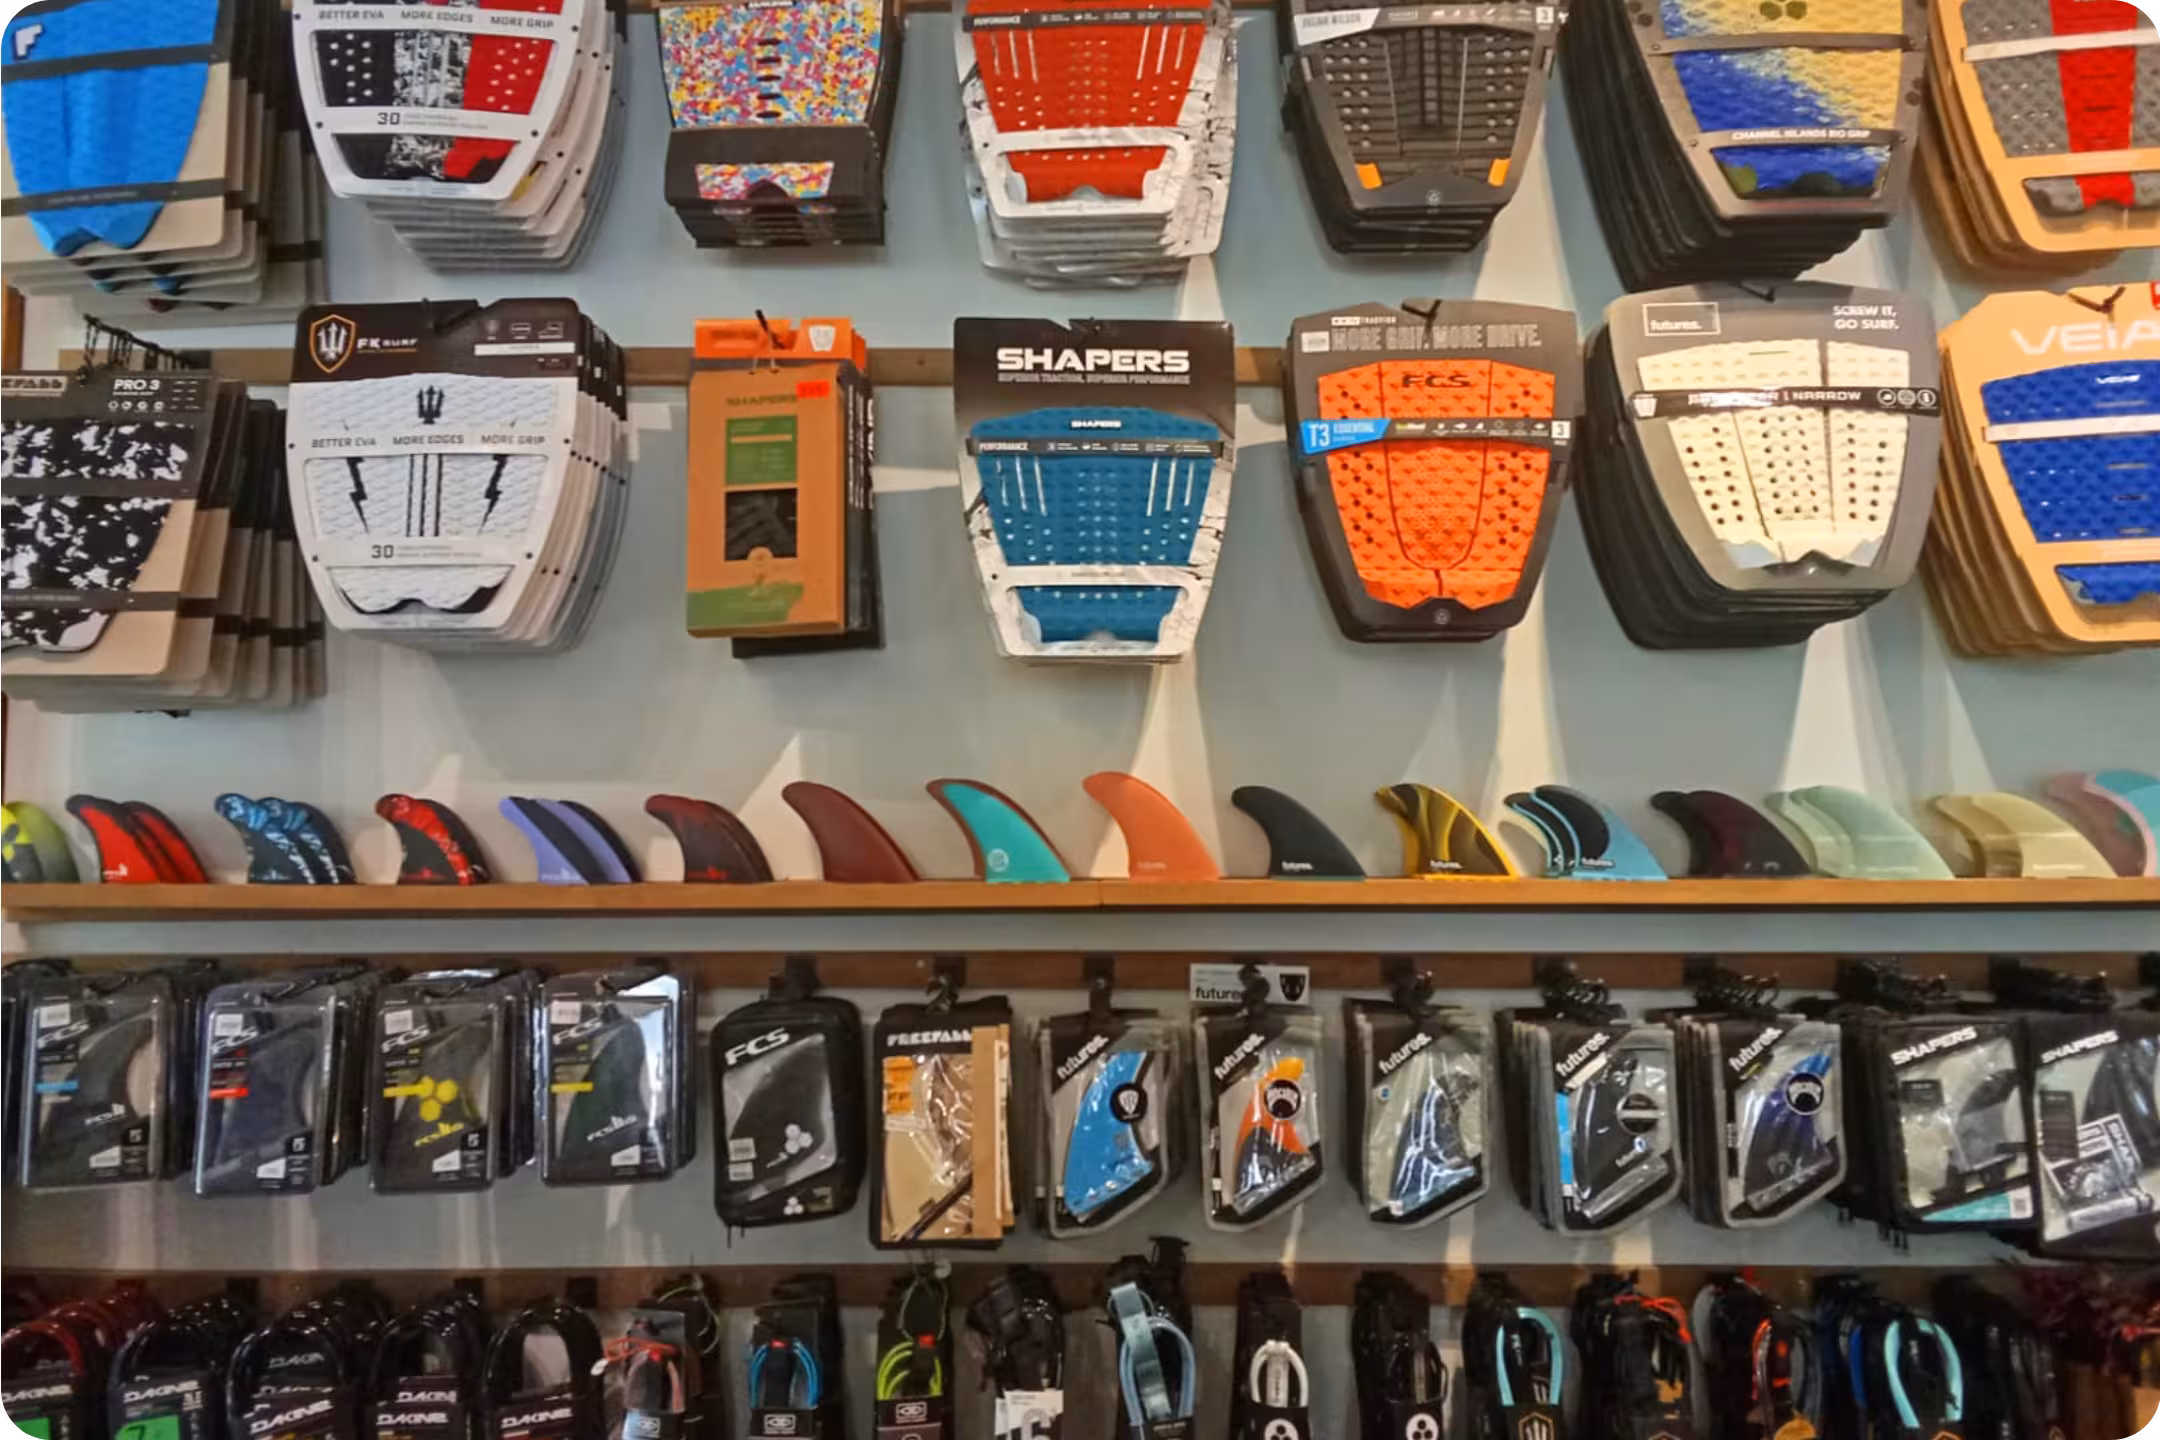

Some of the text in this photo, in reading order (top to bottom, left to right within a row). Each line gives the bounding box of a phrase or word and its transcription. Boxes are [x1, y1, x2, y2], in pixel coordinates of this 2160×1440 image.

[319, 10, 554, 28] BETTER EVA MORE EDGES MORE GRIP
[378, 113, 400, 125] 30
[1732, 130, 1782, 140] CHANNEL
[1783, 129, 1827, 139] ISLANDS
[1833, 305, 1878, 317] SCREW
[1834, 318, 1858, 330] GO
[997, 348, 1190, 372] SHAPERS
[113, 379, 161, 391] PRO 3
[1402, 374, 1471, 388] FCS
[1792, 391, 1862, 401] NARROW
[311, 434, 546, 448] BETTER EVA MORE EDGES MORE GRIP
[1308, 422, 1330, 448] T3
[371, 545, 395, 559] 30
[1196, 986, 1244, 999] future
[37, 1022, 89, 1049] FCS
[212, 1025, 258, 1055] FCS
[382, 1025, 430, 1053] FCS
[552, 1017, 601, 1045] FCS
[725, 1027, 790, 1065] FCS
[1890, 1026, 1977, 1066] SHAPERS
[2041, 1030, 2119, 1063] SHAPERS
[123, 1380, 199, 1403] DAKINE
[250, 1400, 334, 1433] DAKINE
[376, 1412, 448, 1426] DAKINE
[502, 1408, 573, 1429] DAKINE
